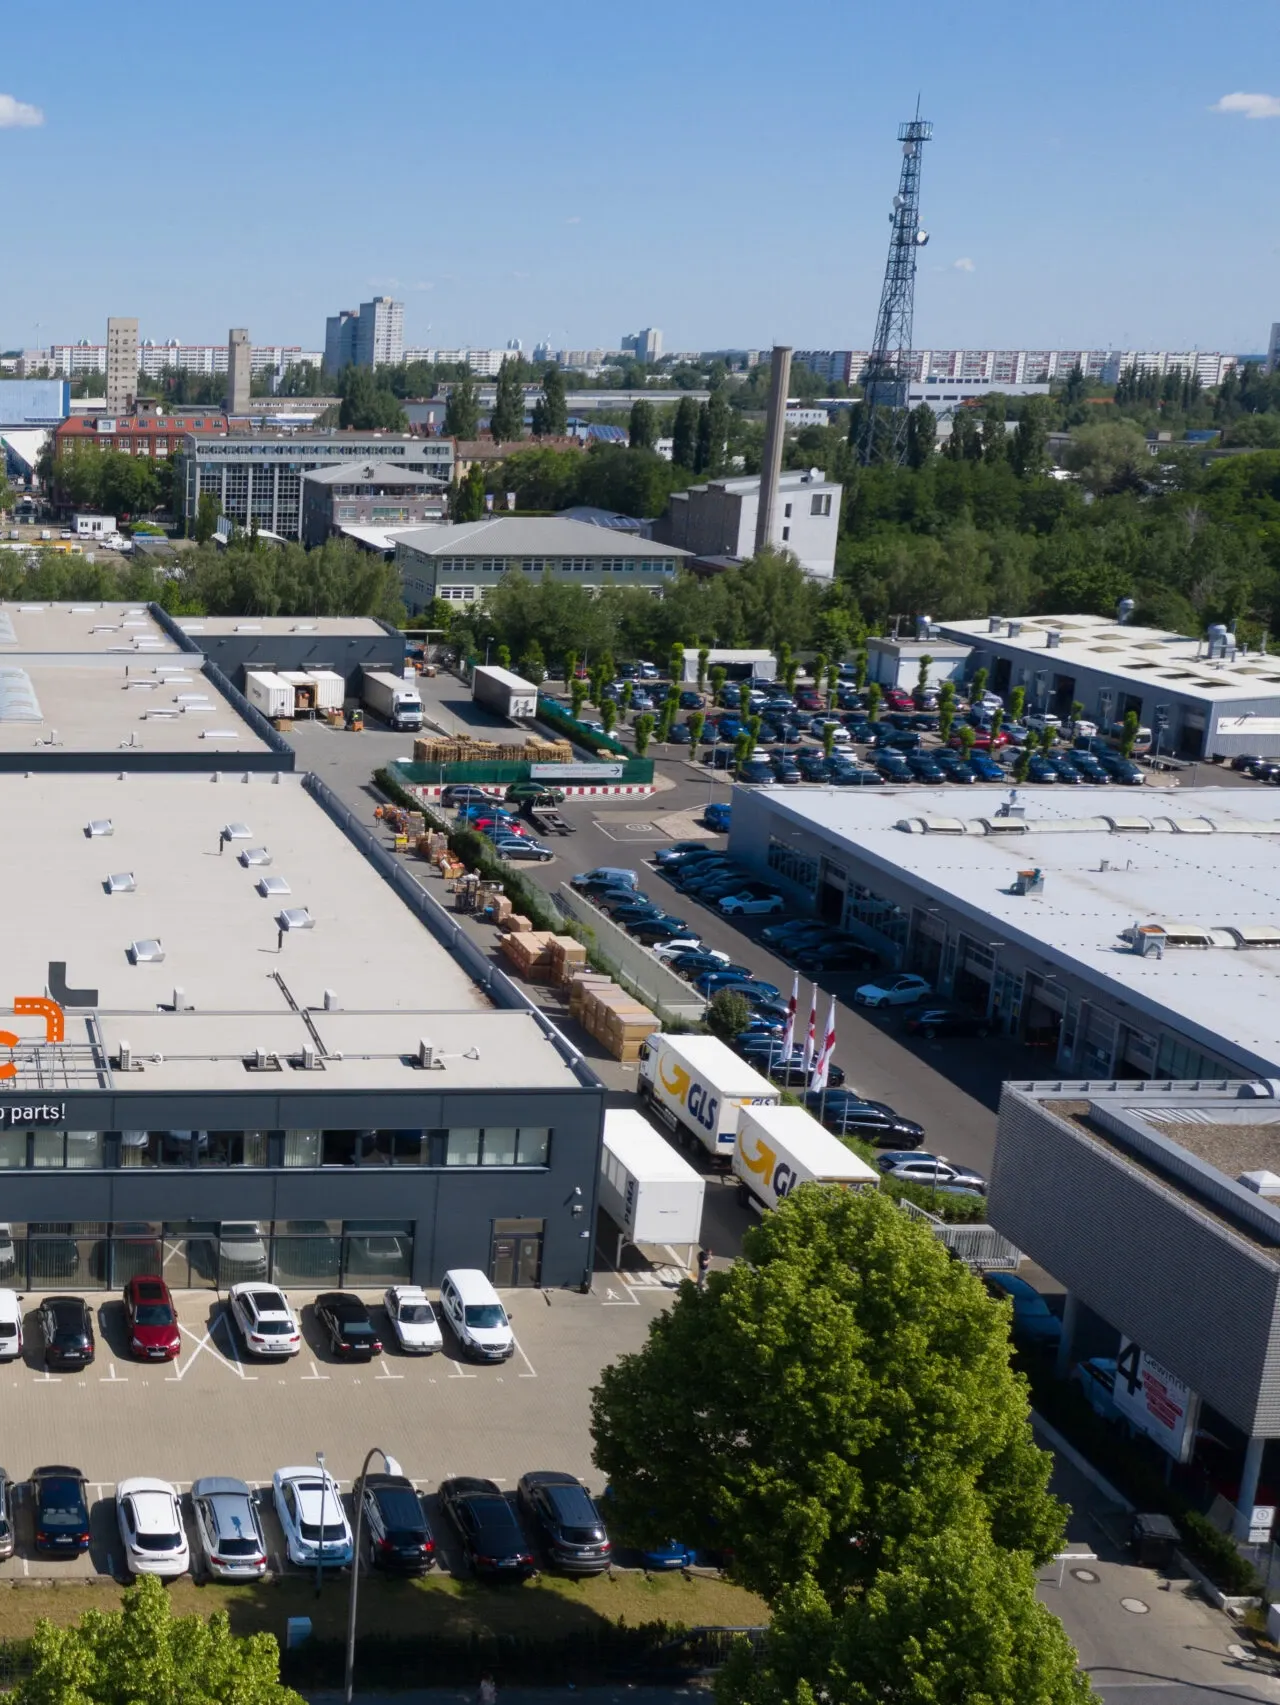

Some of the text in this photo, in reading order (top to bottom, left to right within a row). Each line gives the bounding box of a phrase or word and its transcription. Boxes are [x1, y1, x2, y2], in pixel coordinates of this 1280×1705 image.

[11, 1102, 67, 1124] parts!
[688, 1083, 718, 1131] GLS
[624, 1179, 635, 1225] PEMA
[773, 1162, 806, 1198] GL
[1117, 1342, 1143, 1397] 4
